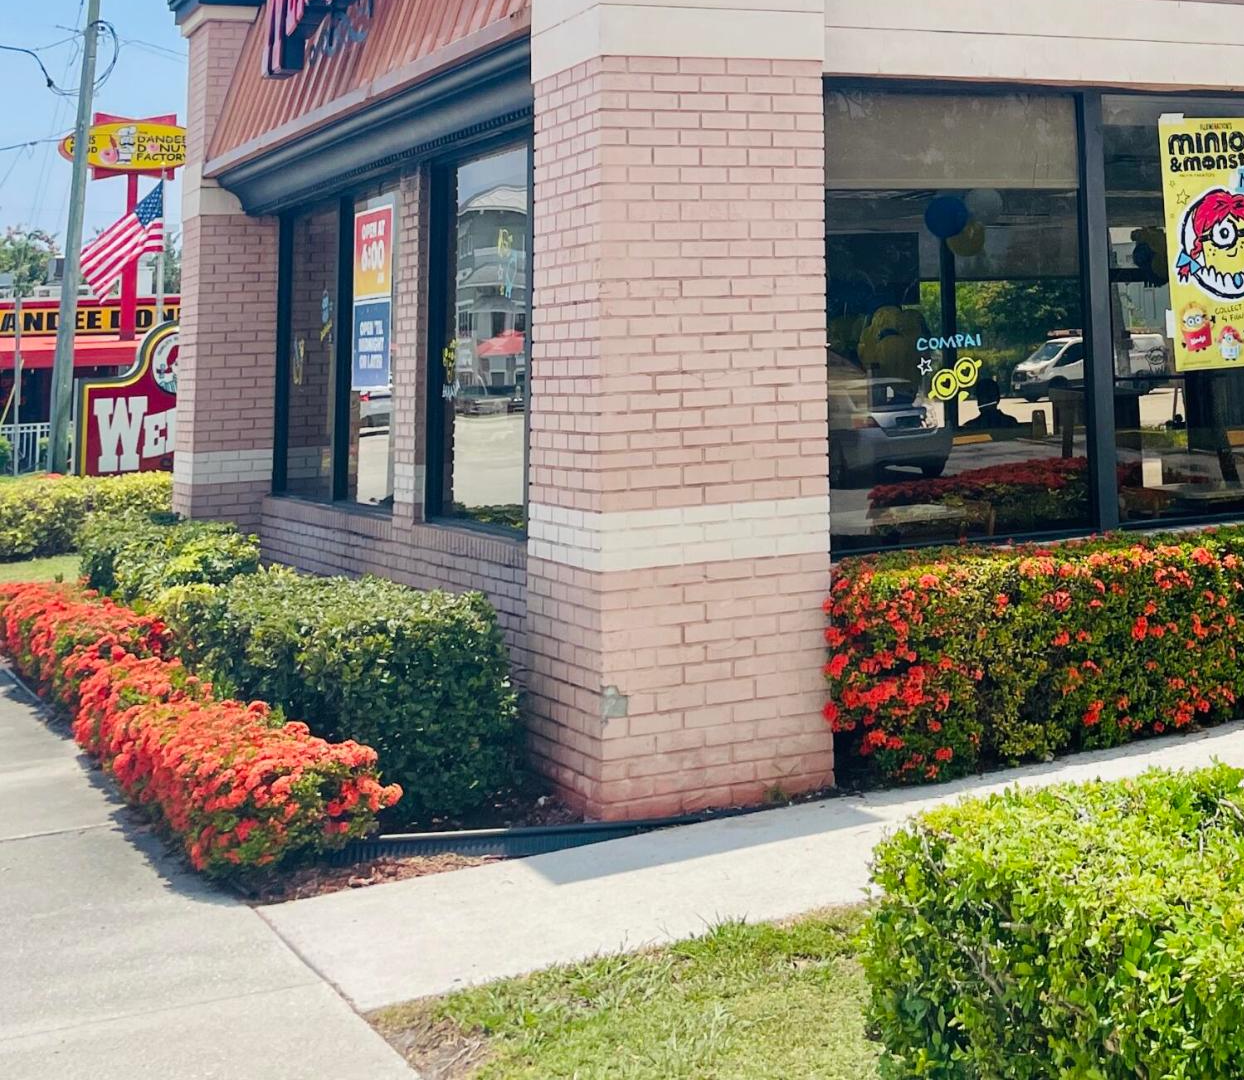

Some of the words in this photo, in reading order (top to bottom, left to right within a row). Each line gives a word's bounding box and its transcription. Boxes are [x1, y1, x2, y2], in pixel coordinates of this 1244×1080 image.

[361, 222, 377, 240] OPEN
[378, 219, 386, 236] AT
[361, 240, 385, 272] 6:00
[1214, 303, 1242, 315] COLLECT
[94, 397, 176, 472] WE
